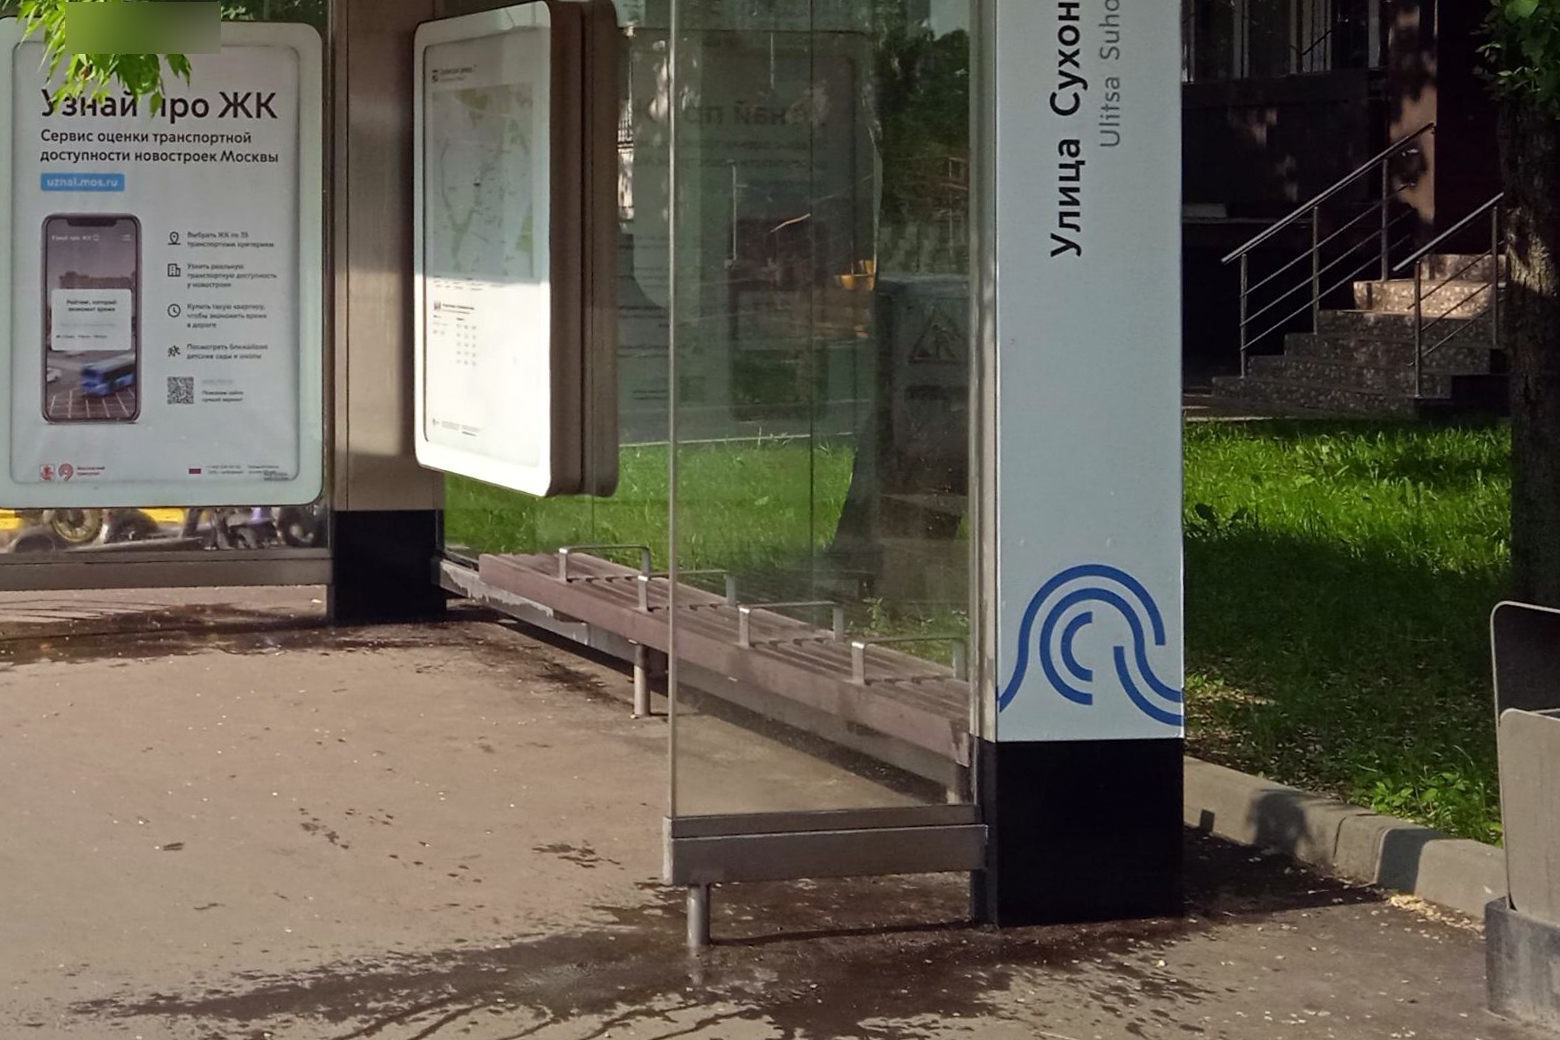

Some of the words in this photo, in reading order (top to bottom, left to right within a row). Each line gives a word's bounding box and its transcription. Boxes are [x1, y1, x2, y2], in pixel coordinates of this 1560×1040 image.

[218, 91, 278, 119] ЖК
[1098, 75, 1121, 148] Ulitsa
[40, 129, 94, 145] Сервис
[97, 131, 149, 146] оценки
[152, 132, 252, 146] транспортной
[40, 149, 130, 163] доступности
[135, 151, 217, 163] новостроек
[220, 151, 279, 163] Москвы
[1049, 137, 1086, 258] Улица
